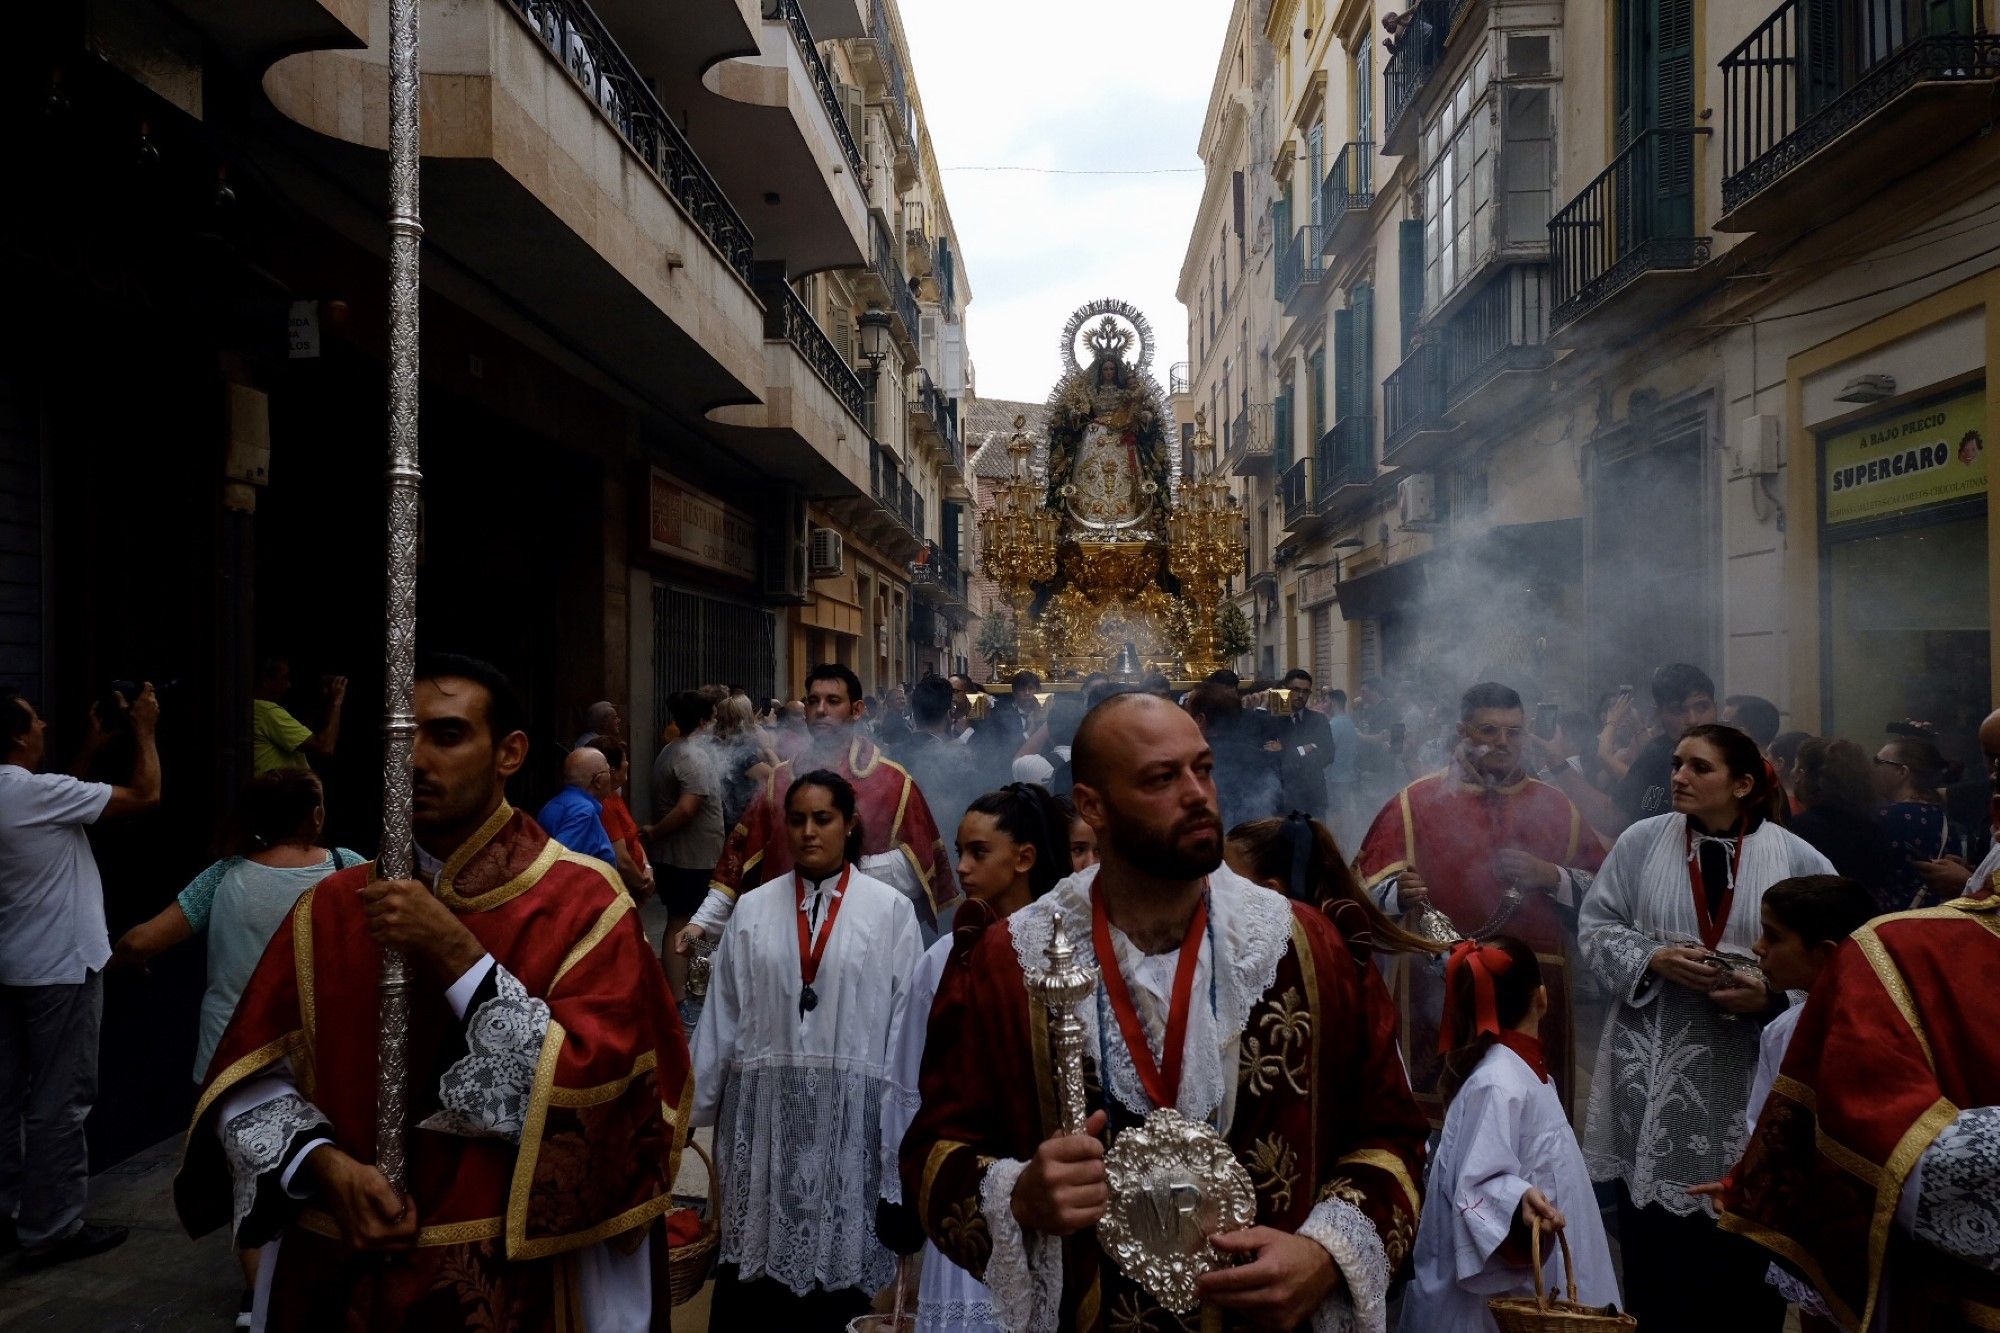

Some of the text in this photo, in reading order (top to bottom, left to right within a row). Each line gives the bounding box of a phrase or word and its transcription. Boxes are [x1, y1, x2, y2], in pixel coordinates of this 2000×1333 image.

[1860, 412, 1946, 448] A BAJO PRECIO
[1832, 442, 1948, 492] SUPERCARO
[683, 500, 735, 541] RESTAURANTE
